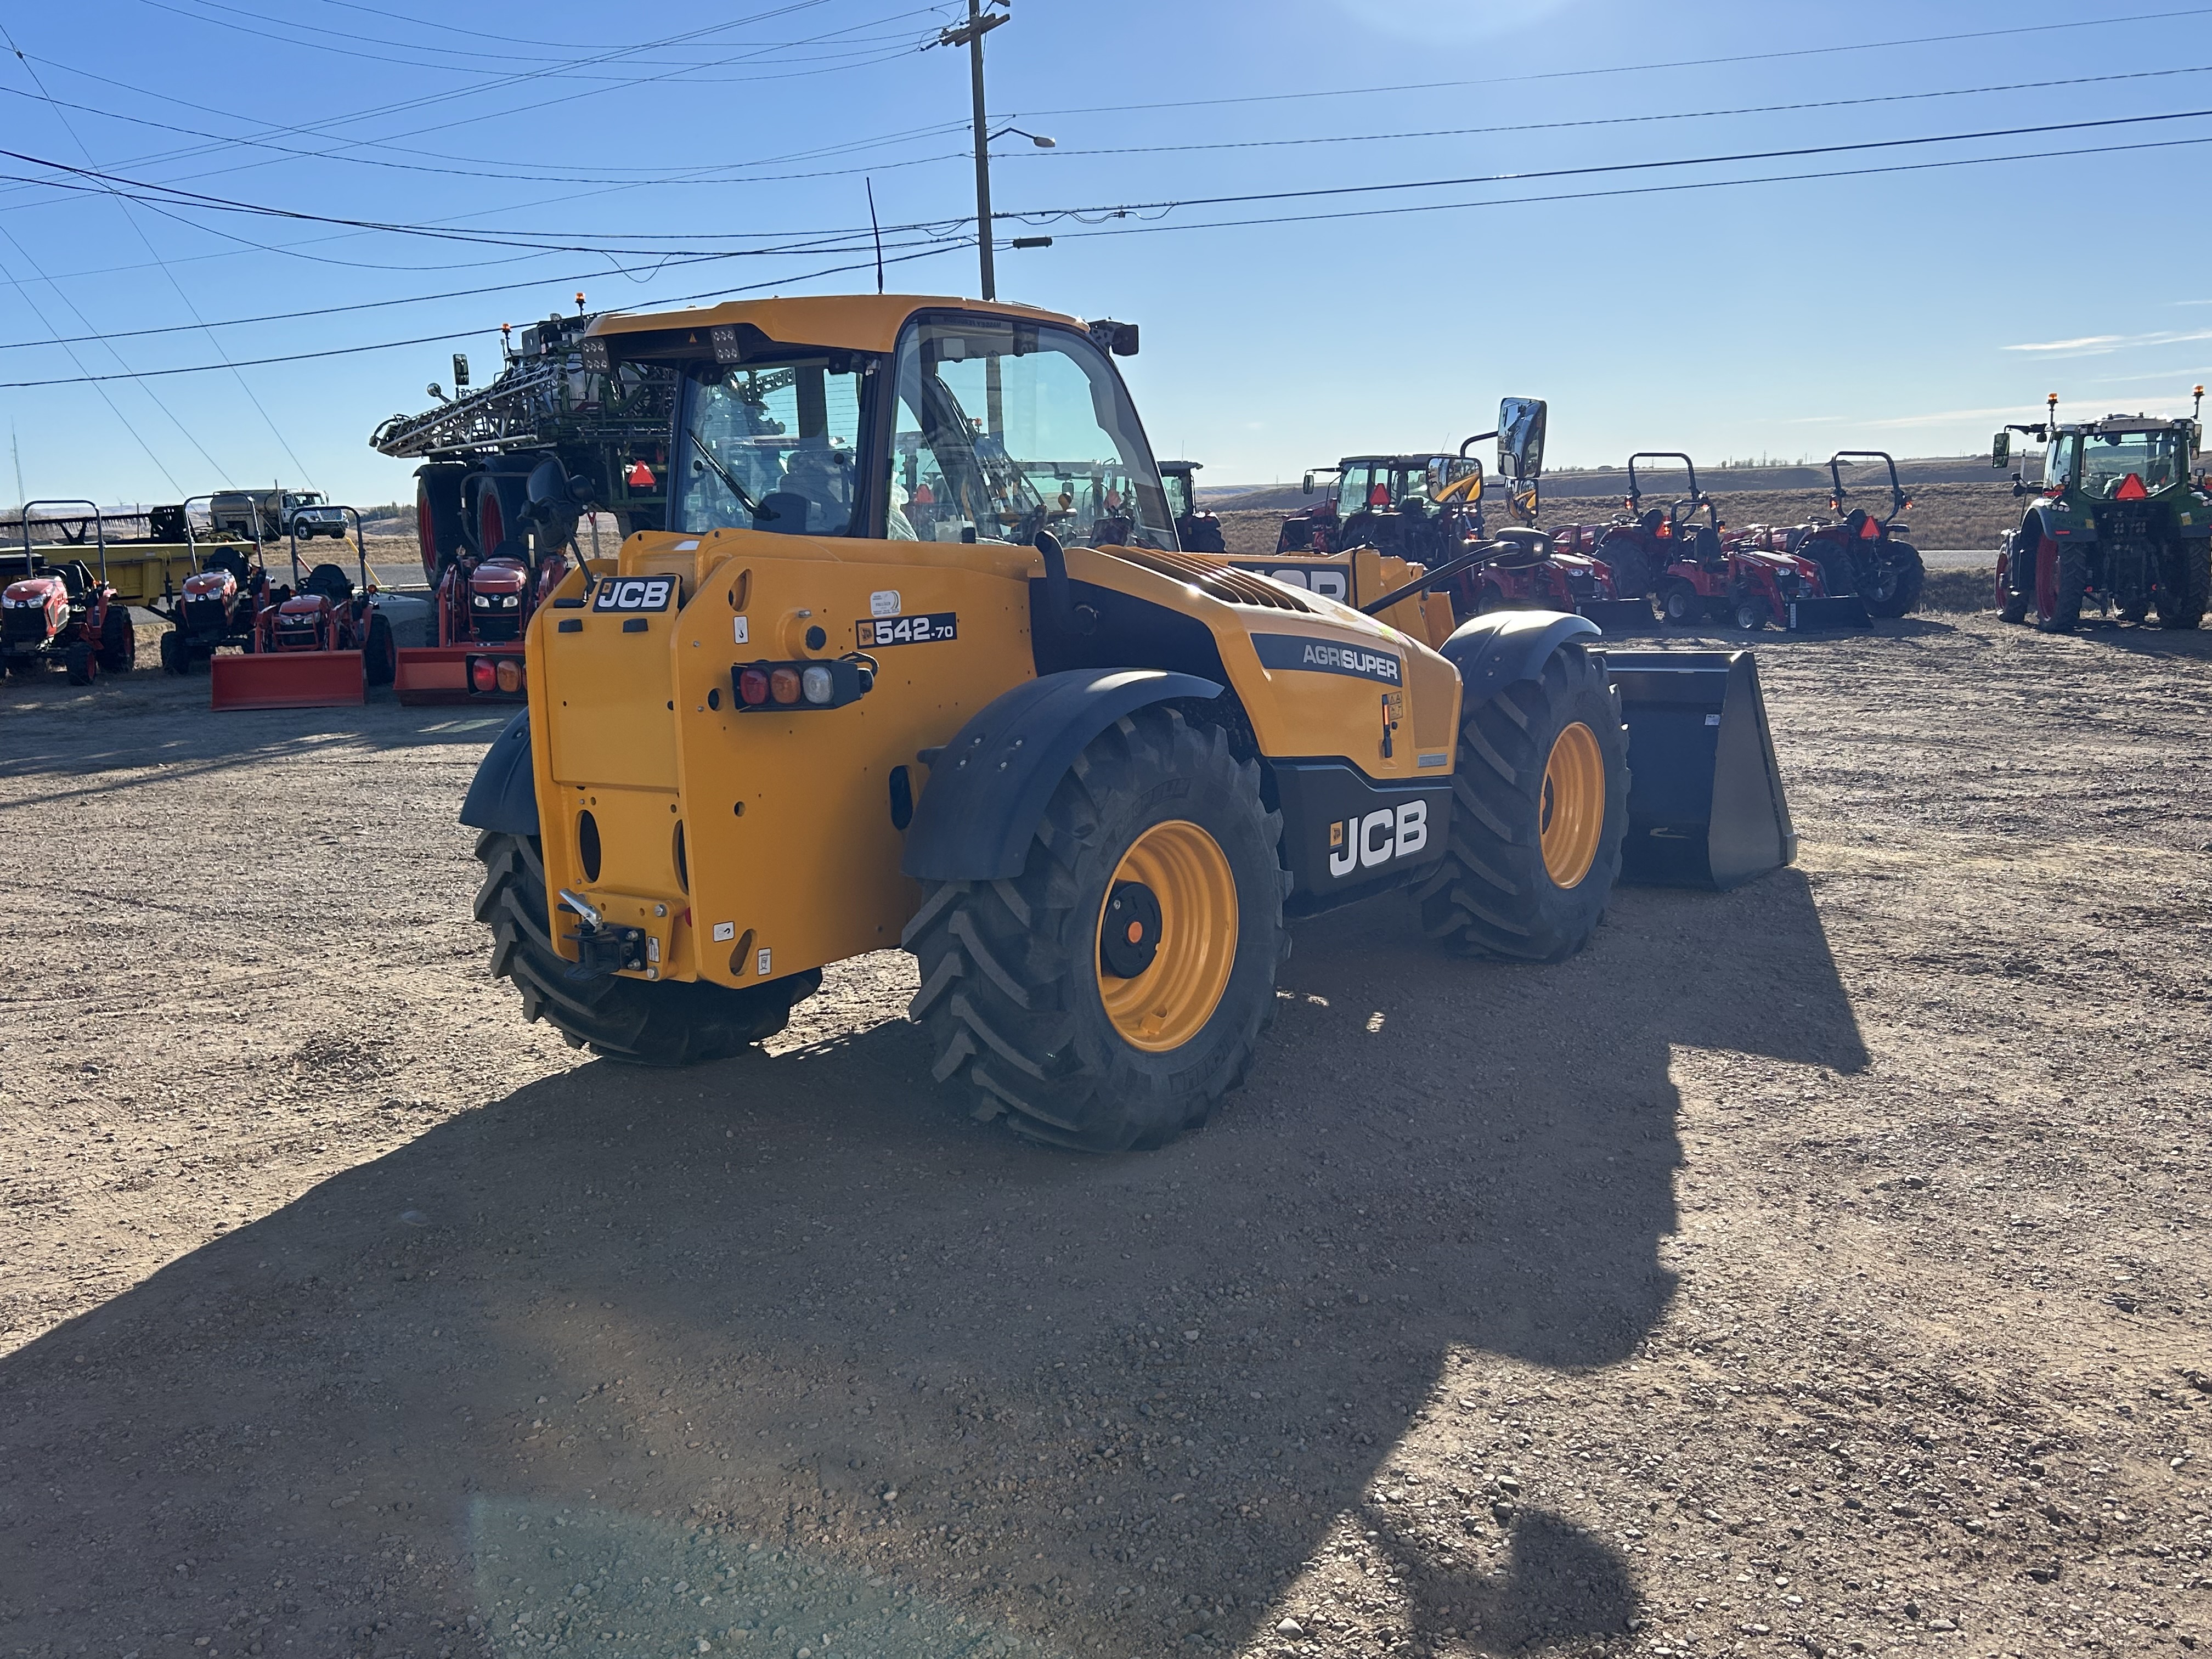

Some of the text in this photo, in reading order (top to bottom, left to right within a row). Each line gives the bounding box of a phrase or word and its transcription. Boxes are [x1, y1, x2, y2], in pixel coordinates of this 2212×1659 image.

[598, 582, 669, 608] JCB
[876, 617, 953, 645] 542-70
[1329, 799, 1427, 877] JCB
